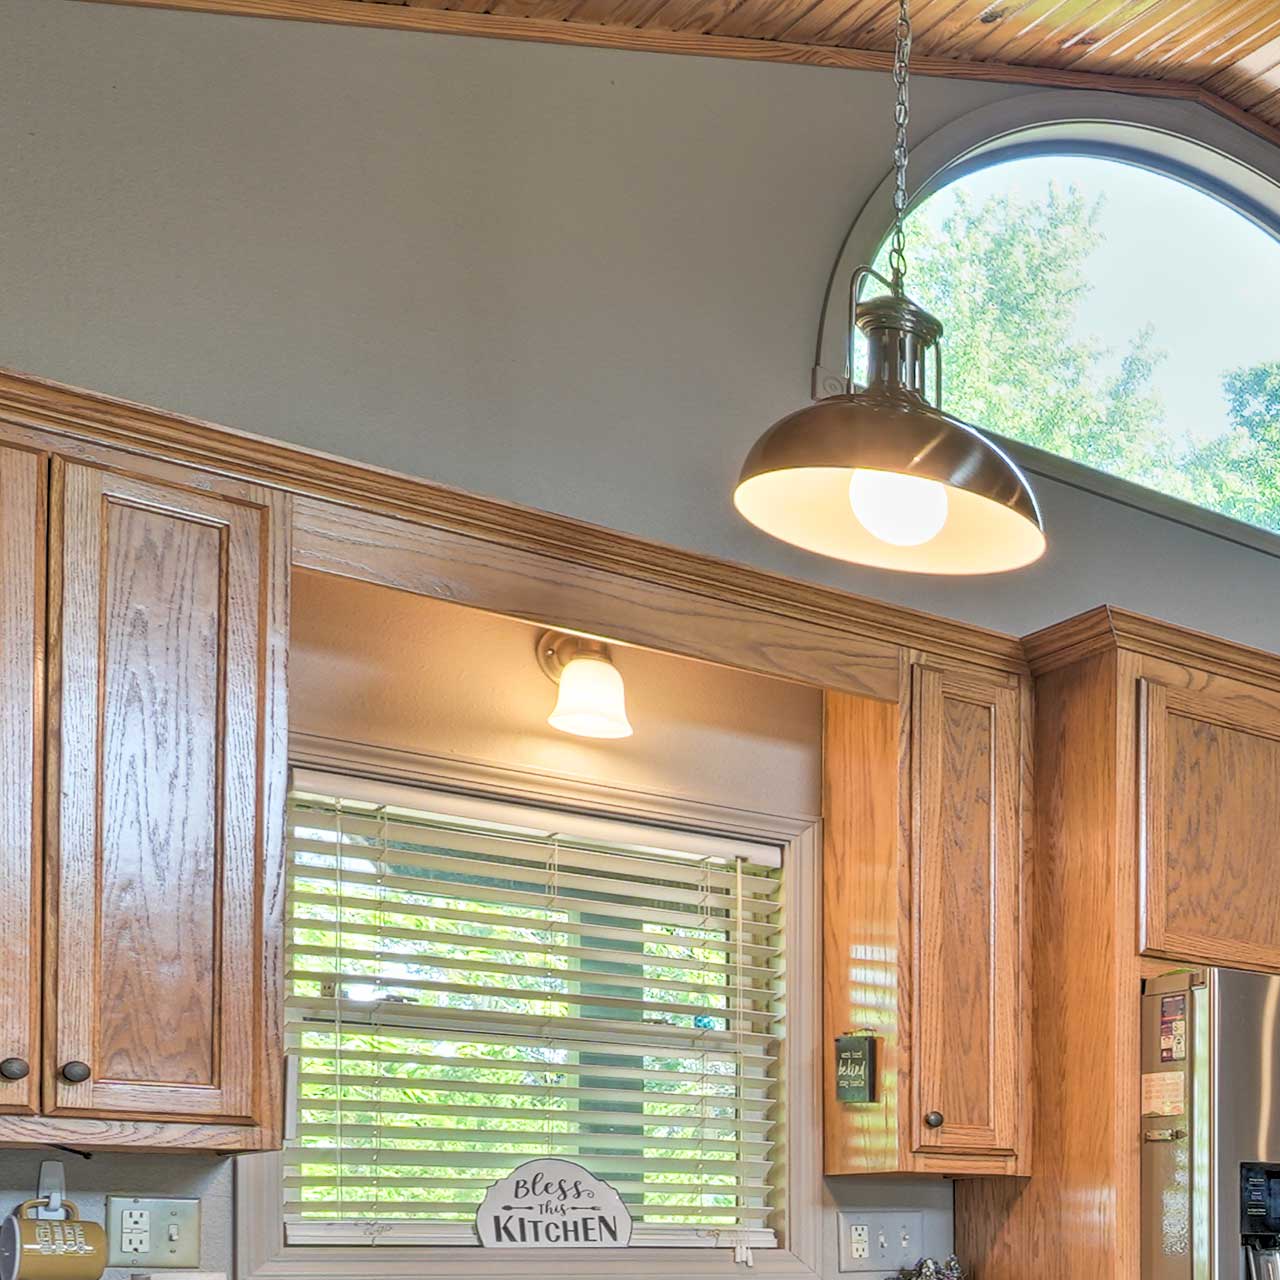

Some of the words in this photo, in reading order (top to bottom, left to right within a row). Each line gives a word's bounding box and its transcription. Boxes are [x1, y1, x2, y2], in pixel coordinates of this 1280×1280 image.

[514, 1172, 595, 1201] Bless
[538, 1200, 570, 1216] This
[493, 1215, 618, 1243] KITCHEN
